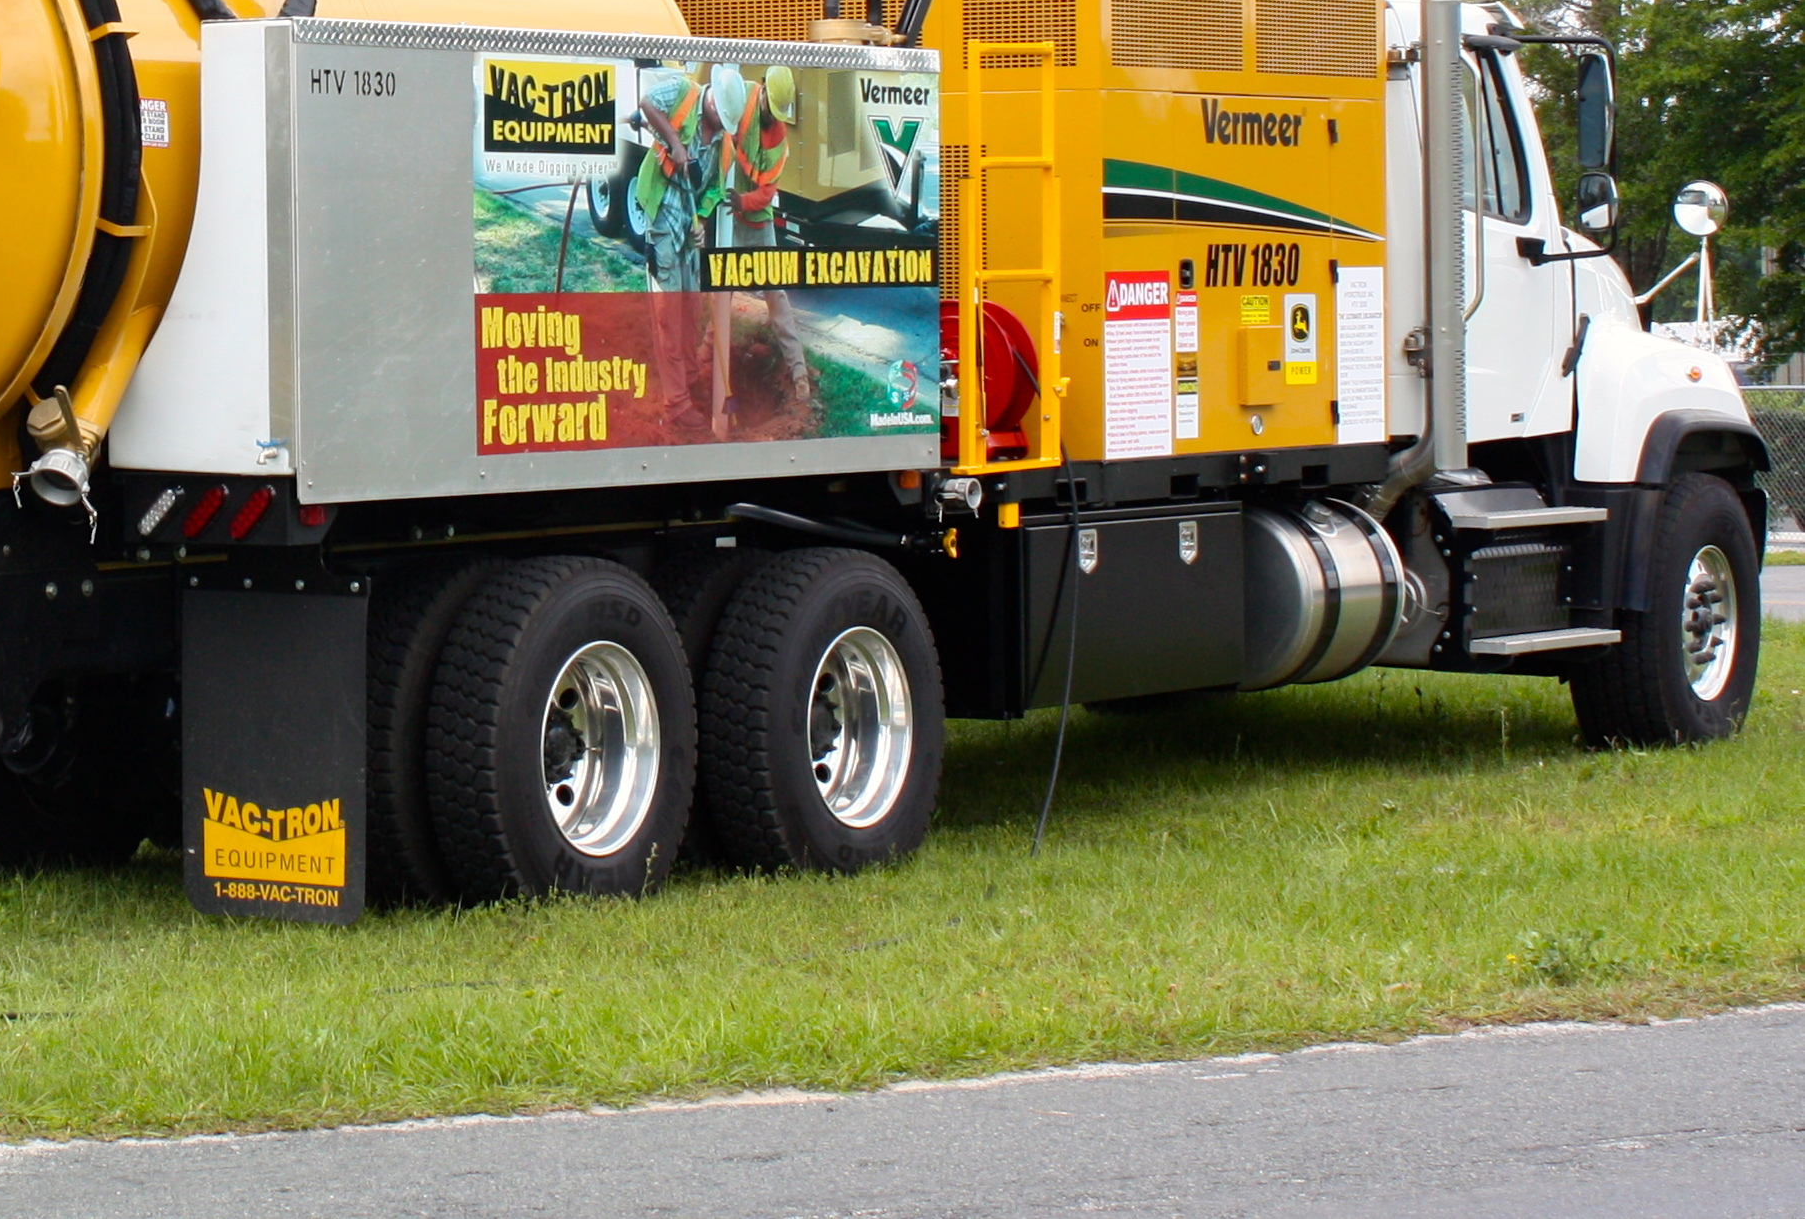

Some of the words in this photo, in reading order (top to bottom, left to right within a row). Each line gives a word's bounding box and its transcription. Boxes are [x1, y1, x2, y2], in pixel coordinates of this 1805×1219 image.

[310, 68, 346, 95] HTV
[354, 70, 396, 97] 1830
[489, 63, 609, 118] VAC-TRON
[860, 77, 930, 106] Vermeer
[139, 98, 167, 112] NGER
[492, 119, 612, 145] EQUIPMENT
[1200, 98, 1303, 147] Vermeer
[485, 159, 502, 172] We
[510, 159, 534, 173] Made
[538, 160, 578, 176] Digging
[708, 251, 799, 287] VACUUM
[805, 249, 932, 285] EXCAVATION
[1205, 244, 1247, 287] HTV
[1251, 242, 1300, 287] 1830
[1081, 303, 1101, 313] OFF
[1119, 282, 1169, 306] DANGER
[1242, 296, 1268, 306] CAUTION
[481, 305, 581, 356] Moving
[1083, 338, 1099, 347] ON
[497, 355, 539, 394] the
[545, 354, 647, 398] Industry
[1291, 366, 1311, 375] POWER
[483, 393, 607, 446] Forward
[203, 787, 341, 842] VAC-TRON
[215, 848, 336, 875] EQUIPMENT
[213, 881, 339, 907] 1-888-VAC-TRON
